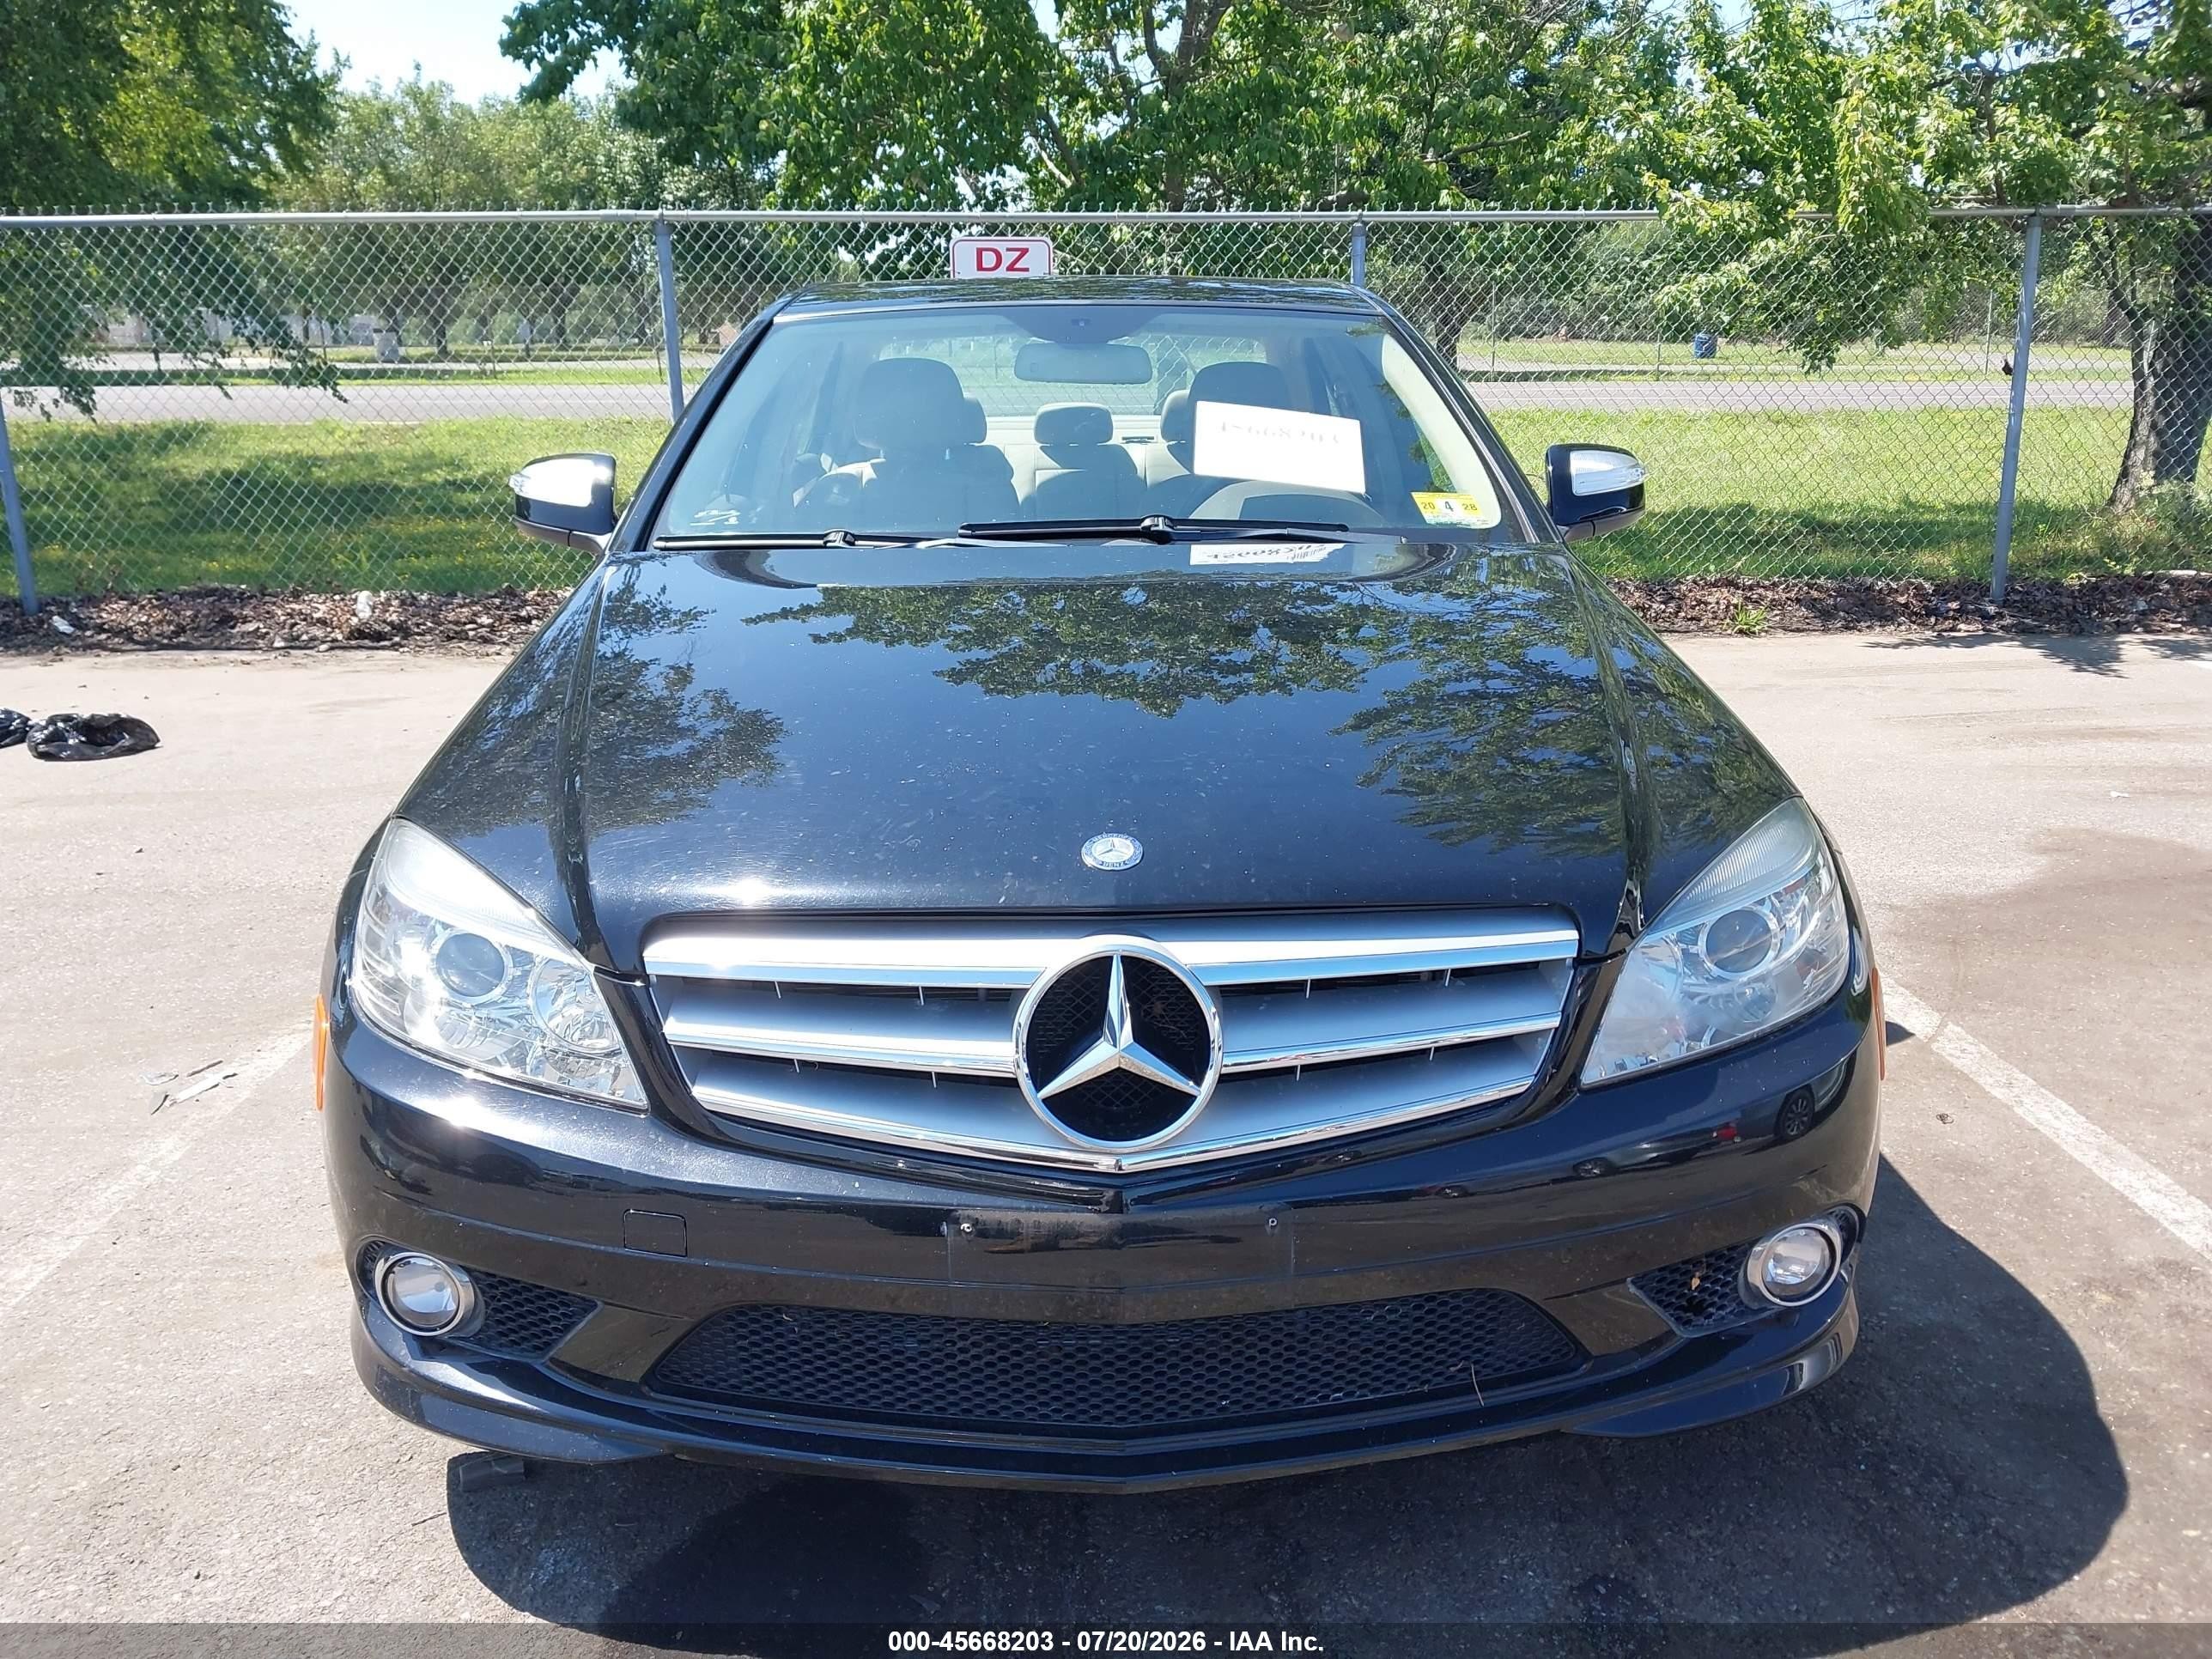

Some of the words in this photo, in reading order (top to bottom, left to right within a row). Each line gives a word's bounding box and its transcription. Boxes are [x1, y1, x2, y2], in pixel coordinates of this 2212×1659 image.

[975, 246, 1030, 272] DZ
[1420, 501, 1435, 510] 20
[1444, 501, 1454, 512] 4
